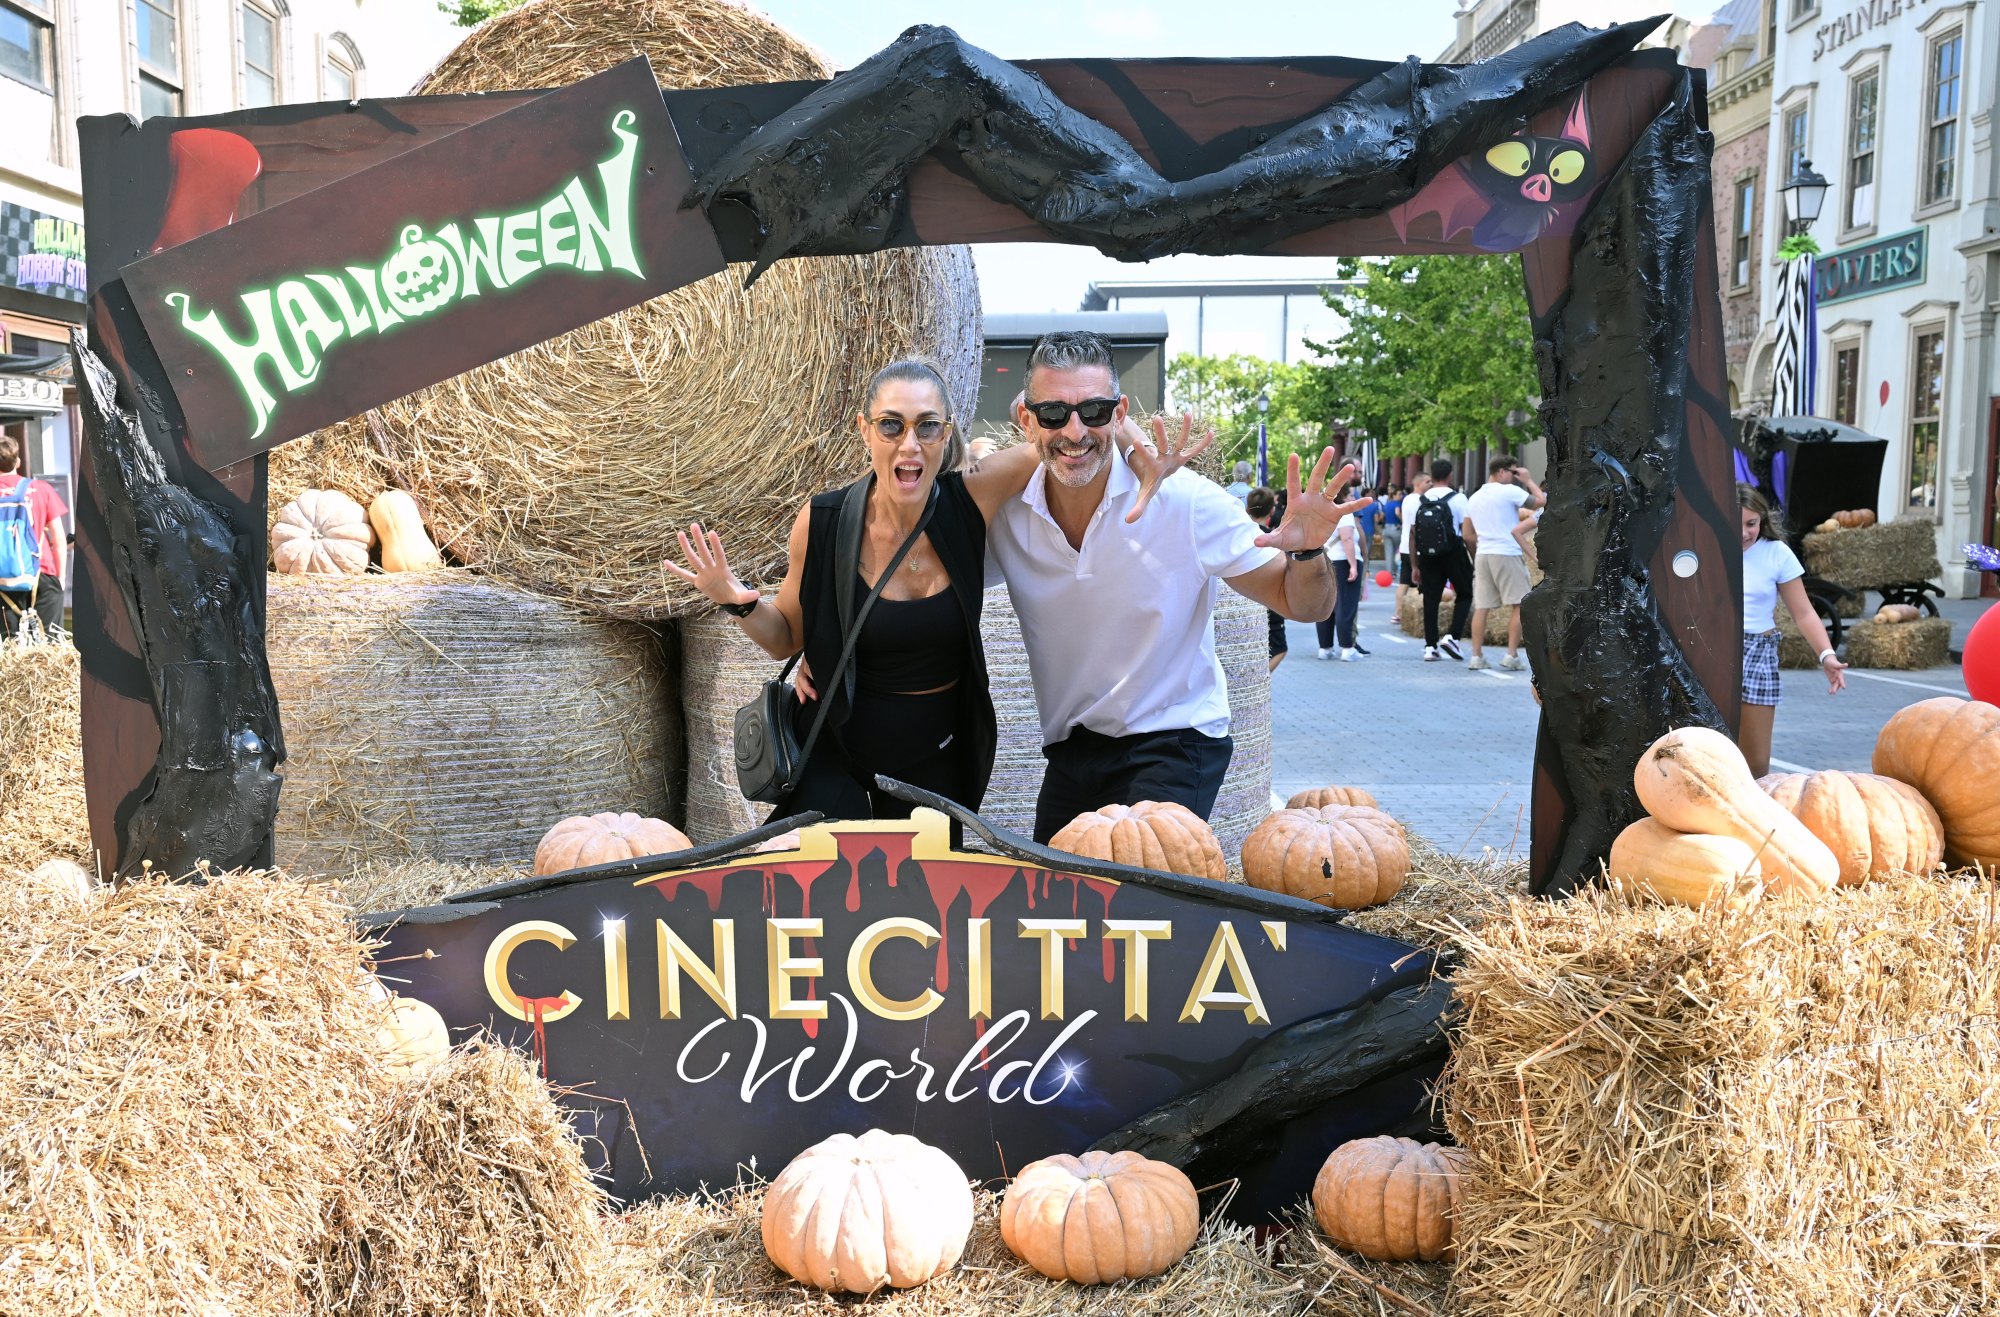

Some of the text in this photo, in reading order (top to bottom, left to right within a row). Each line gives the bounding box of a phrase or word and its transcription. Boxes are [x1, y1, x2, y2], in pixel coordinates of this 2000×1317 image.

[1812, 0, 1927, 62] STANLE
[17, 253, 87, 291] HORROR STO
[164, 109, 647, 440] HALLOWEEN
[1815, 237, 1921, 299] LOWERS
[676, 992, 1098, 1105] World
